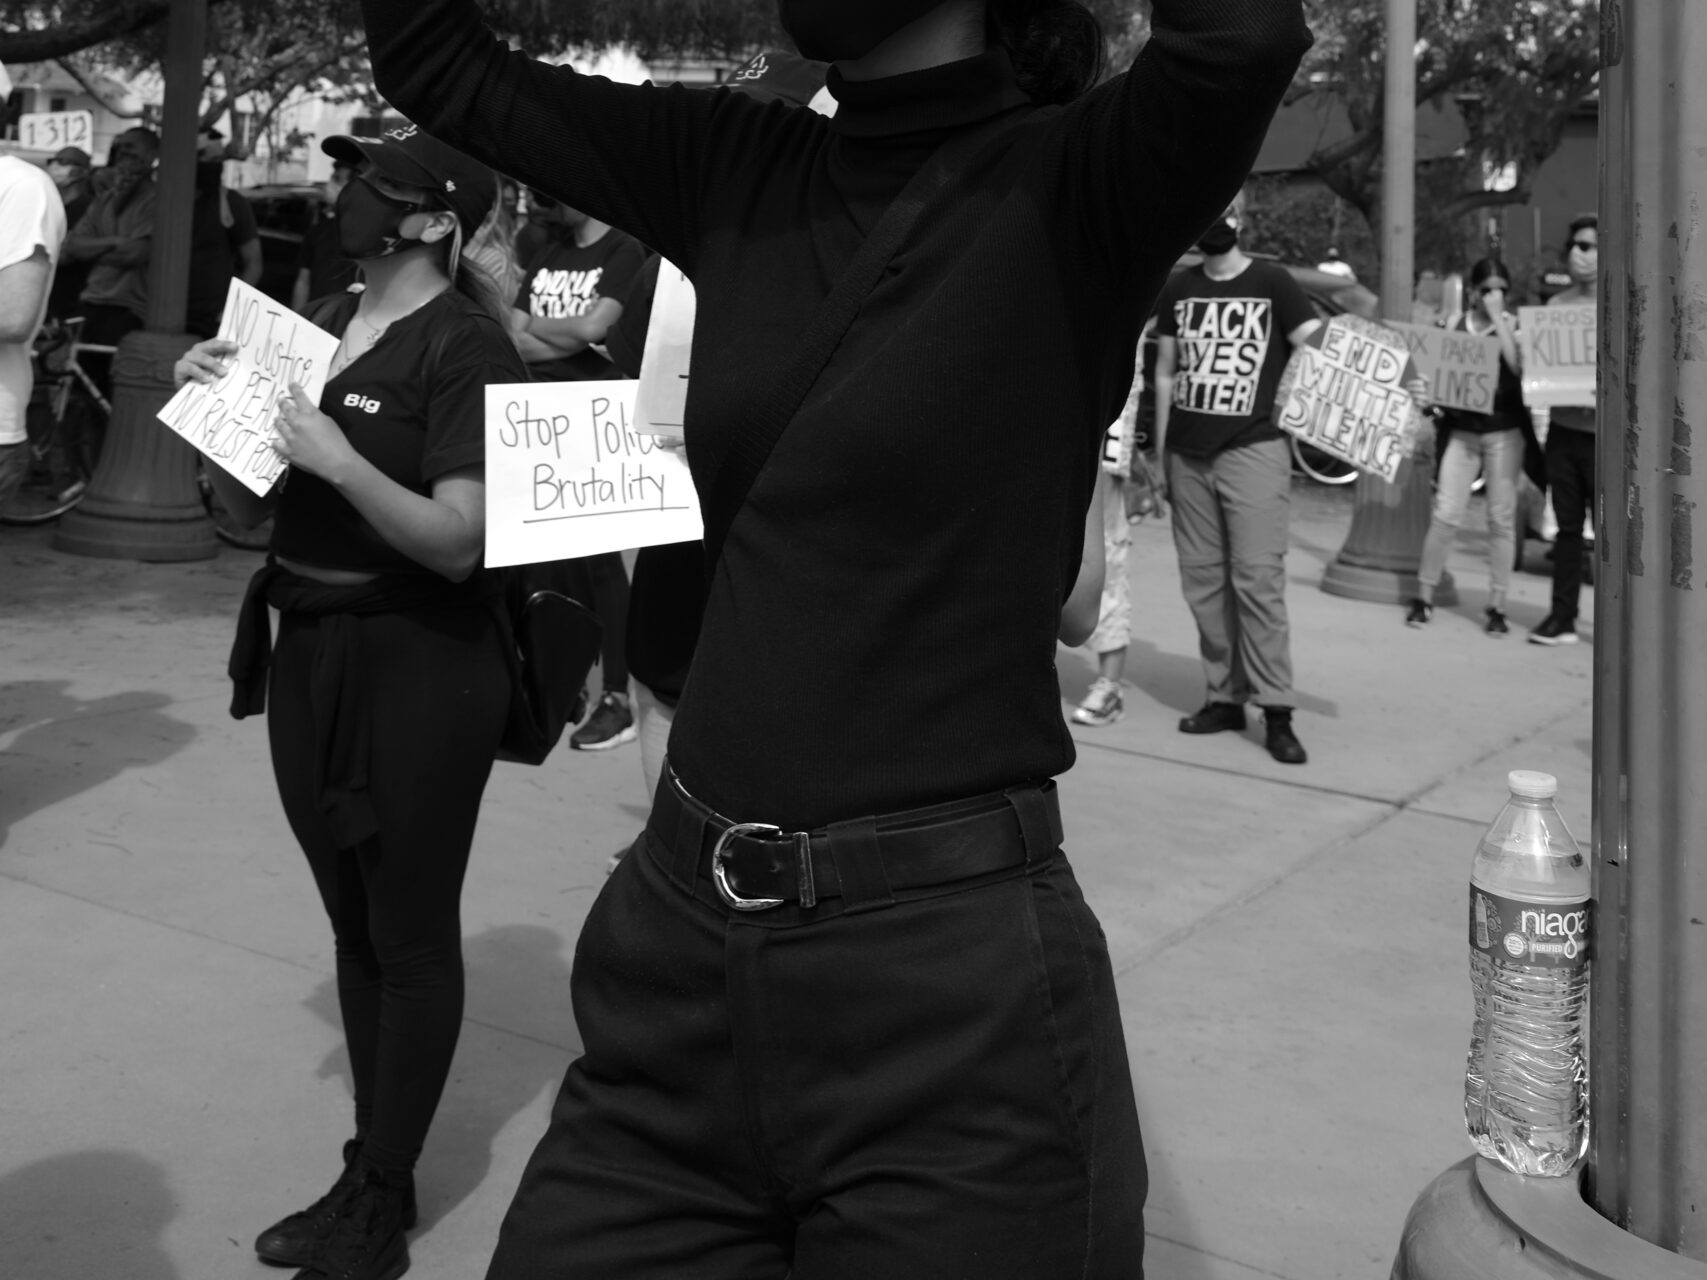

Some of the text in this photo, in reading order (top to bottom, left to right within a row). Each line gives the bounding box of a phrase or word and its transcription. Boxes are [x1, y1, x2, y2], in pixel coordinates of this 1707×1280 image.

[226, 287, 259, 348] NO
[1180, 341, 1260, 376] IVES
[1323, 328, 1400, 384] END
[343, 393, 381, 414] Big
[1174, 377, 1254, 412] TTER
[1299, 351, 1409, 431] WHITE
[1433, 366, 1490, 409] LIVES
[164, 385, 207, 431] NO
[191, 398, 259, 464] RACIST
[499, 400, 570, 459] Stop
[534, 463, 665, 511] Brutality
[1531, 943, 1563, 953] PURIFIED
